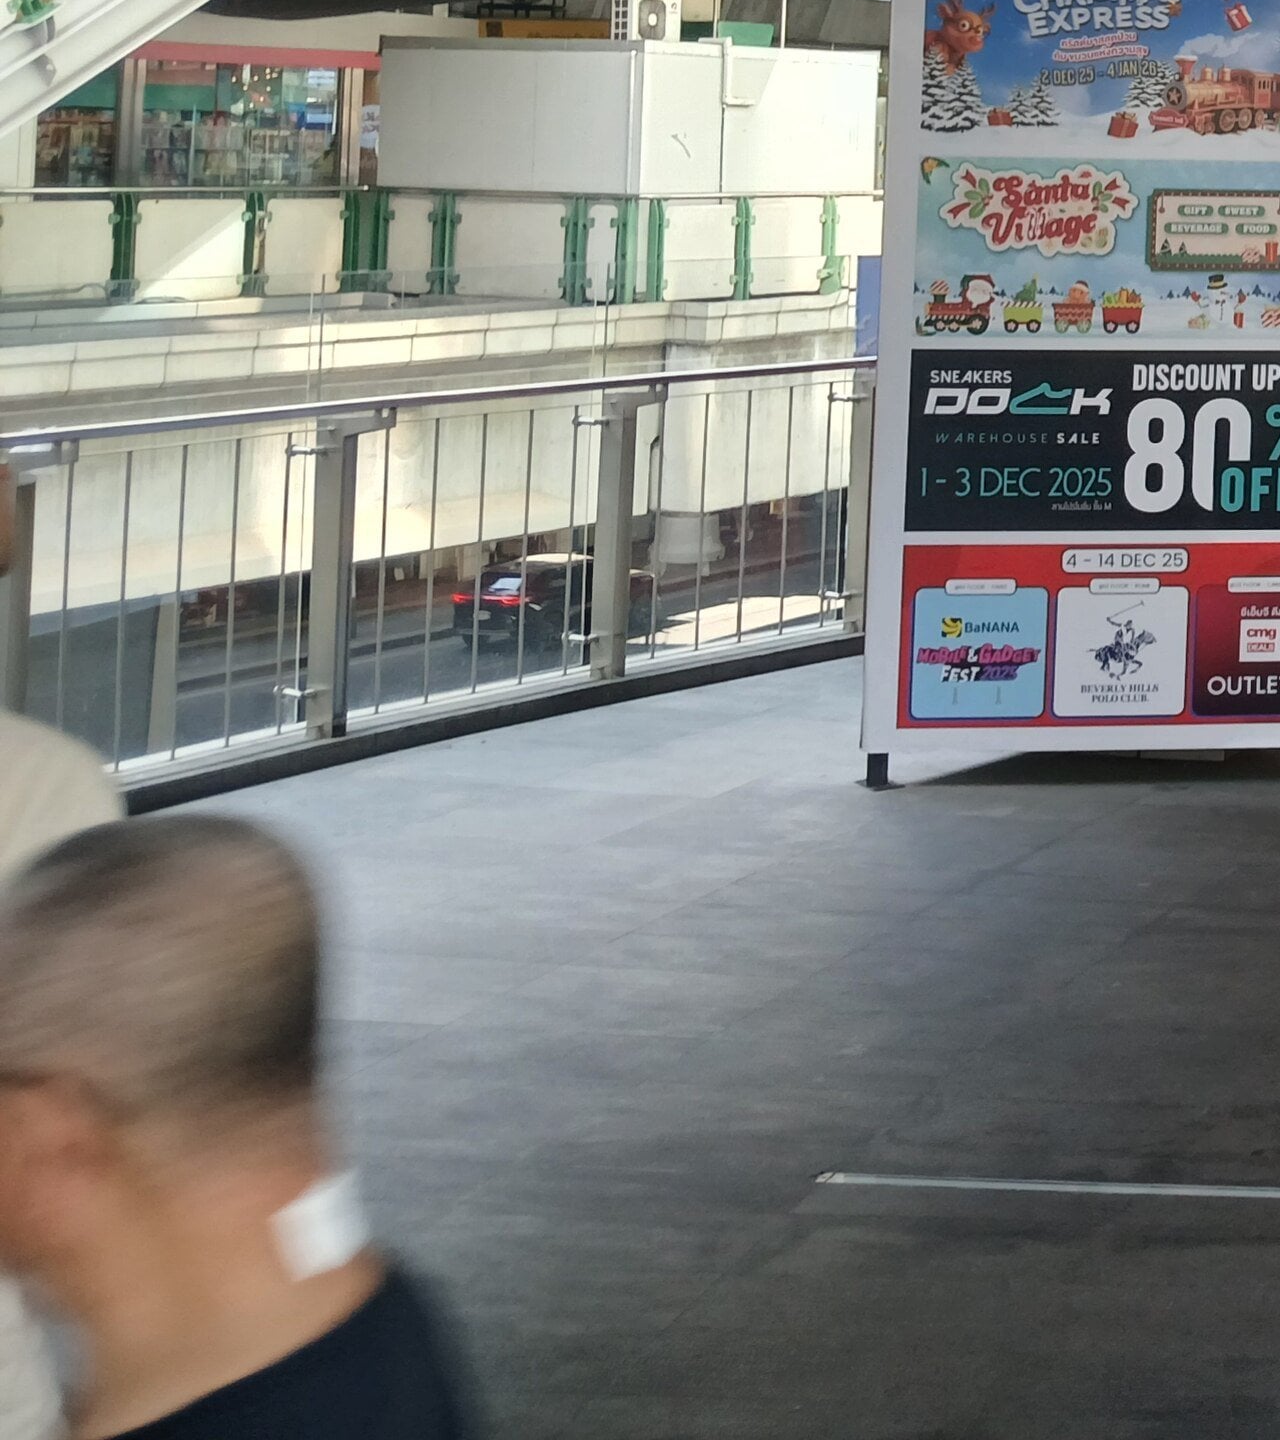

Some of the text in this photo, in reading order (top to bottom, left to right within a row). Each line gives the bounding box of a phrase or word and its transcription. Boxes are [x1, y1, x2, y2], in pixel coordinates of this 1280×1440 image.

[1027, 4, 1172, 37] EXPRESS
[1041, 68, 1050, 85] 2
[1053, 69, 1075, 85] DEC
[1078, 66, 1096, 83] 25
[1107, 62, 1116, 78] 4
[1118, 61, 1138, 78] JAN
[1141, 60, 1158, 77] 26
[992, 174, 1090, 208] Santa
[1183, 206, 1259, 216] GIFT SWEET
[981, 206, 1098, 247] Village
[1170, 224, 1271, 234] BEVERAGE FOOD
[929, 369, 1013, 384] SNEAKERS
[1131, 363, 1246, 392] DISCOUNT
[934, 432, 1101, 445] WAREHOUSE SALE
[921, 467, 928, 497] 1
[954, 467, 971, 497] 3
[979, 467, 1042, 497] DEC
[1047, 467, 1113, 497] 2025
[1066, 553, 1077, 568] 4
[1098, 553, 1115, 568] 14
[1120, 553, 1157, 568] DEC
[1162, 552, 1184, 567] 25
[964, 621, 1020, 634] BaNANA
[1246, 627, 1277, 640] cmg
[940, 664, 982, 683] FEST
[1080, 683, 1159, 694] BEVERLY HILLS
[1091, 693, 1118, 704] POLO
